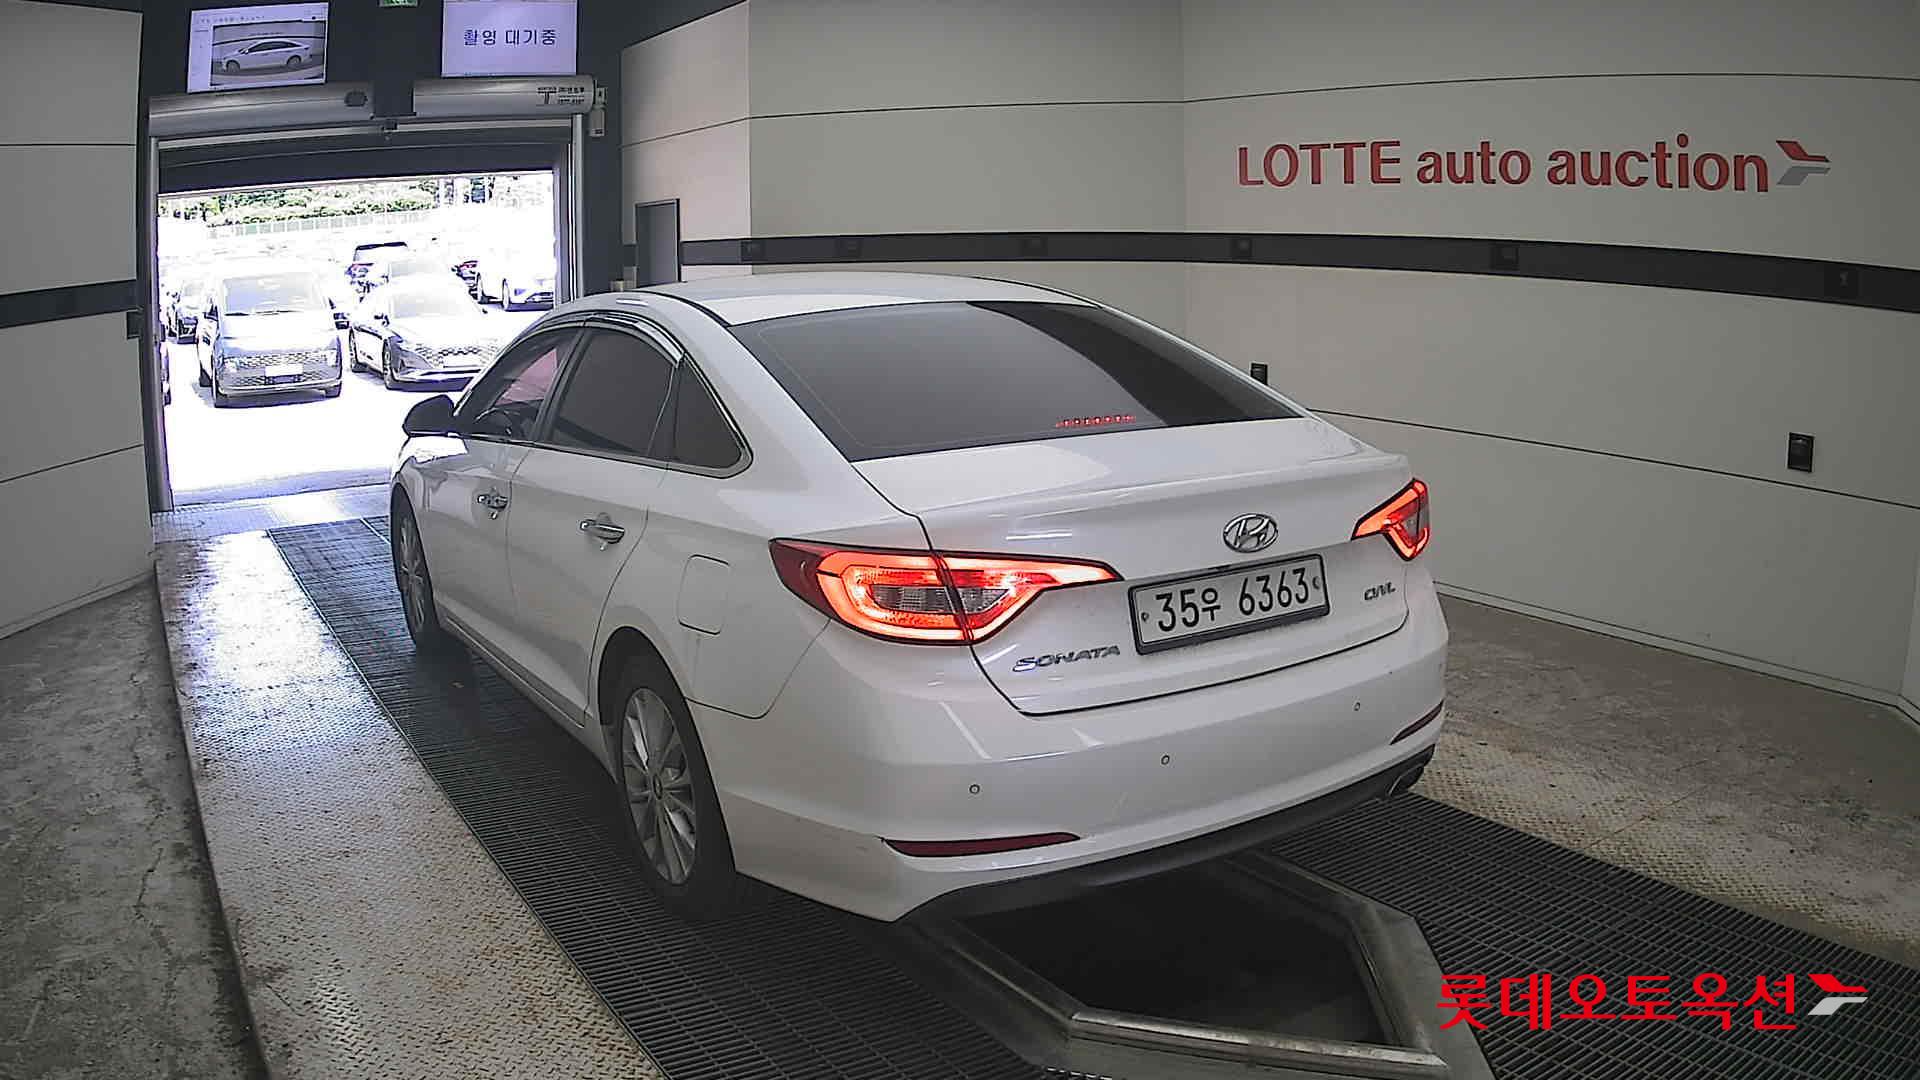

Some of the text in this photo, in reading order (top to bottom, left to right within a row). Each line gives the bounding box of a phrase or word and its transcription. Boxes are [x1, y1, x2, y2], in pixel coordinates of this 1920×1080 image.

[464, 29, 556, 46] 촬영 대기중
[1238, 134, 1769, 192] LOTTE auto auction
[1155, 567, 1309, 632] 35우 6363
[1012, 645, 1120, 673] SONATA
